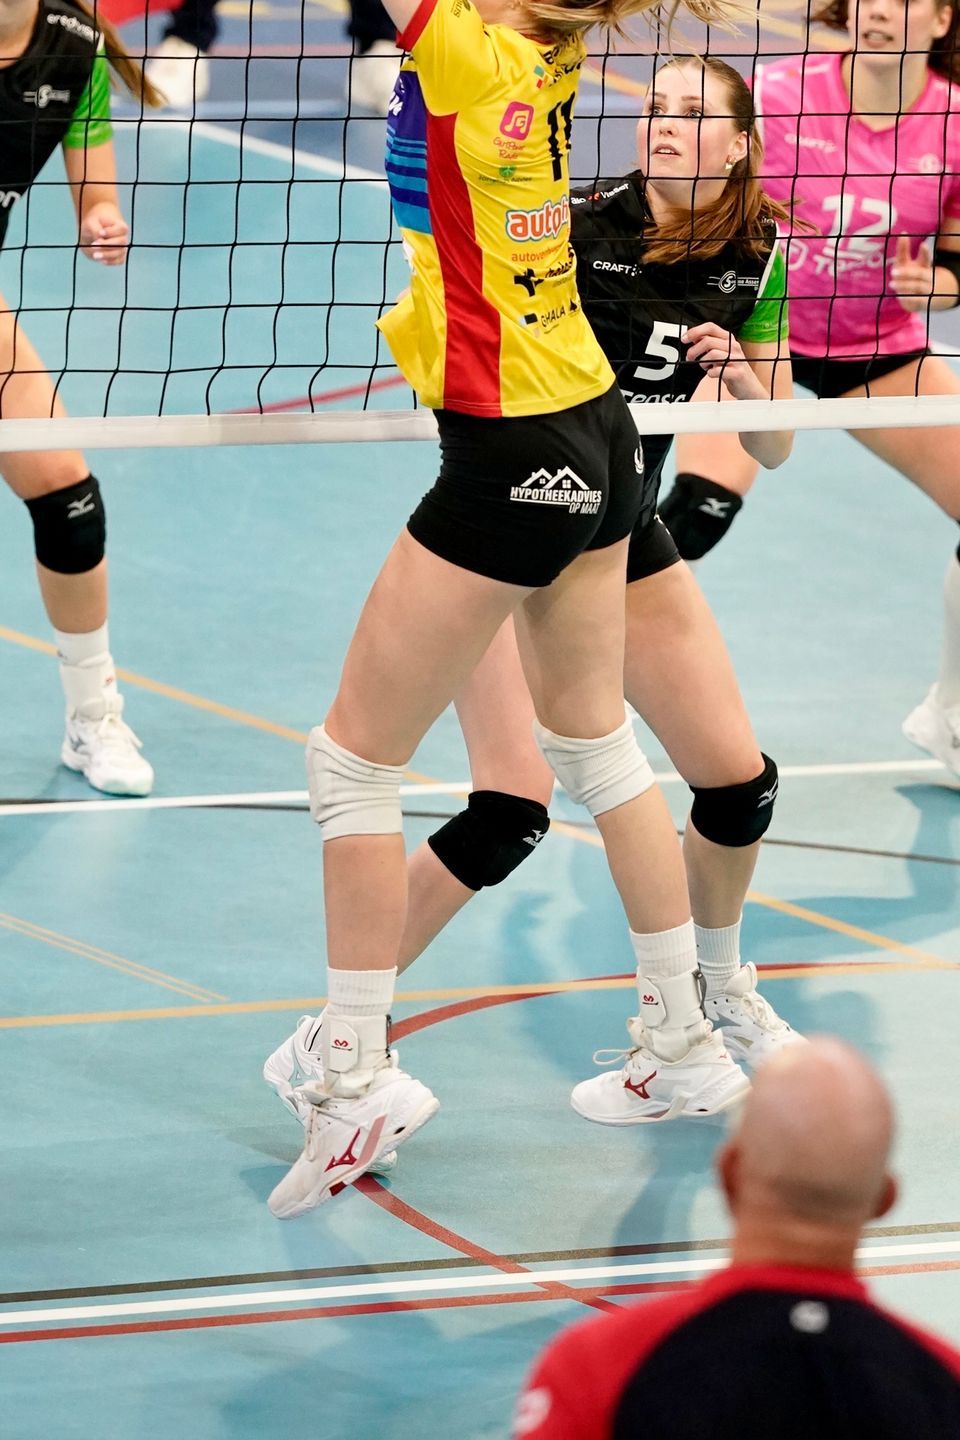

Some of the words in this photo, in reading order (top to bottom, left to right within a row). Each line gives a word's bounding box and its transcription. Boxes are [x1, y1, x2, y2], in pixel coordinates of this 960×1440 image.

[508, 198, 570, 239] autoh
[822, 193, 898, 259] 12
[593, 259, 631, 275] CRAFT
[633, 320, 688, 381] 5
[510, 486, 602, 504] HYPOTHEEKADVIES
[568, 503, 580, 514] OP
[580, 503, 601, 515] MAAT
